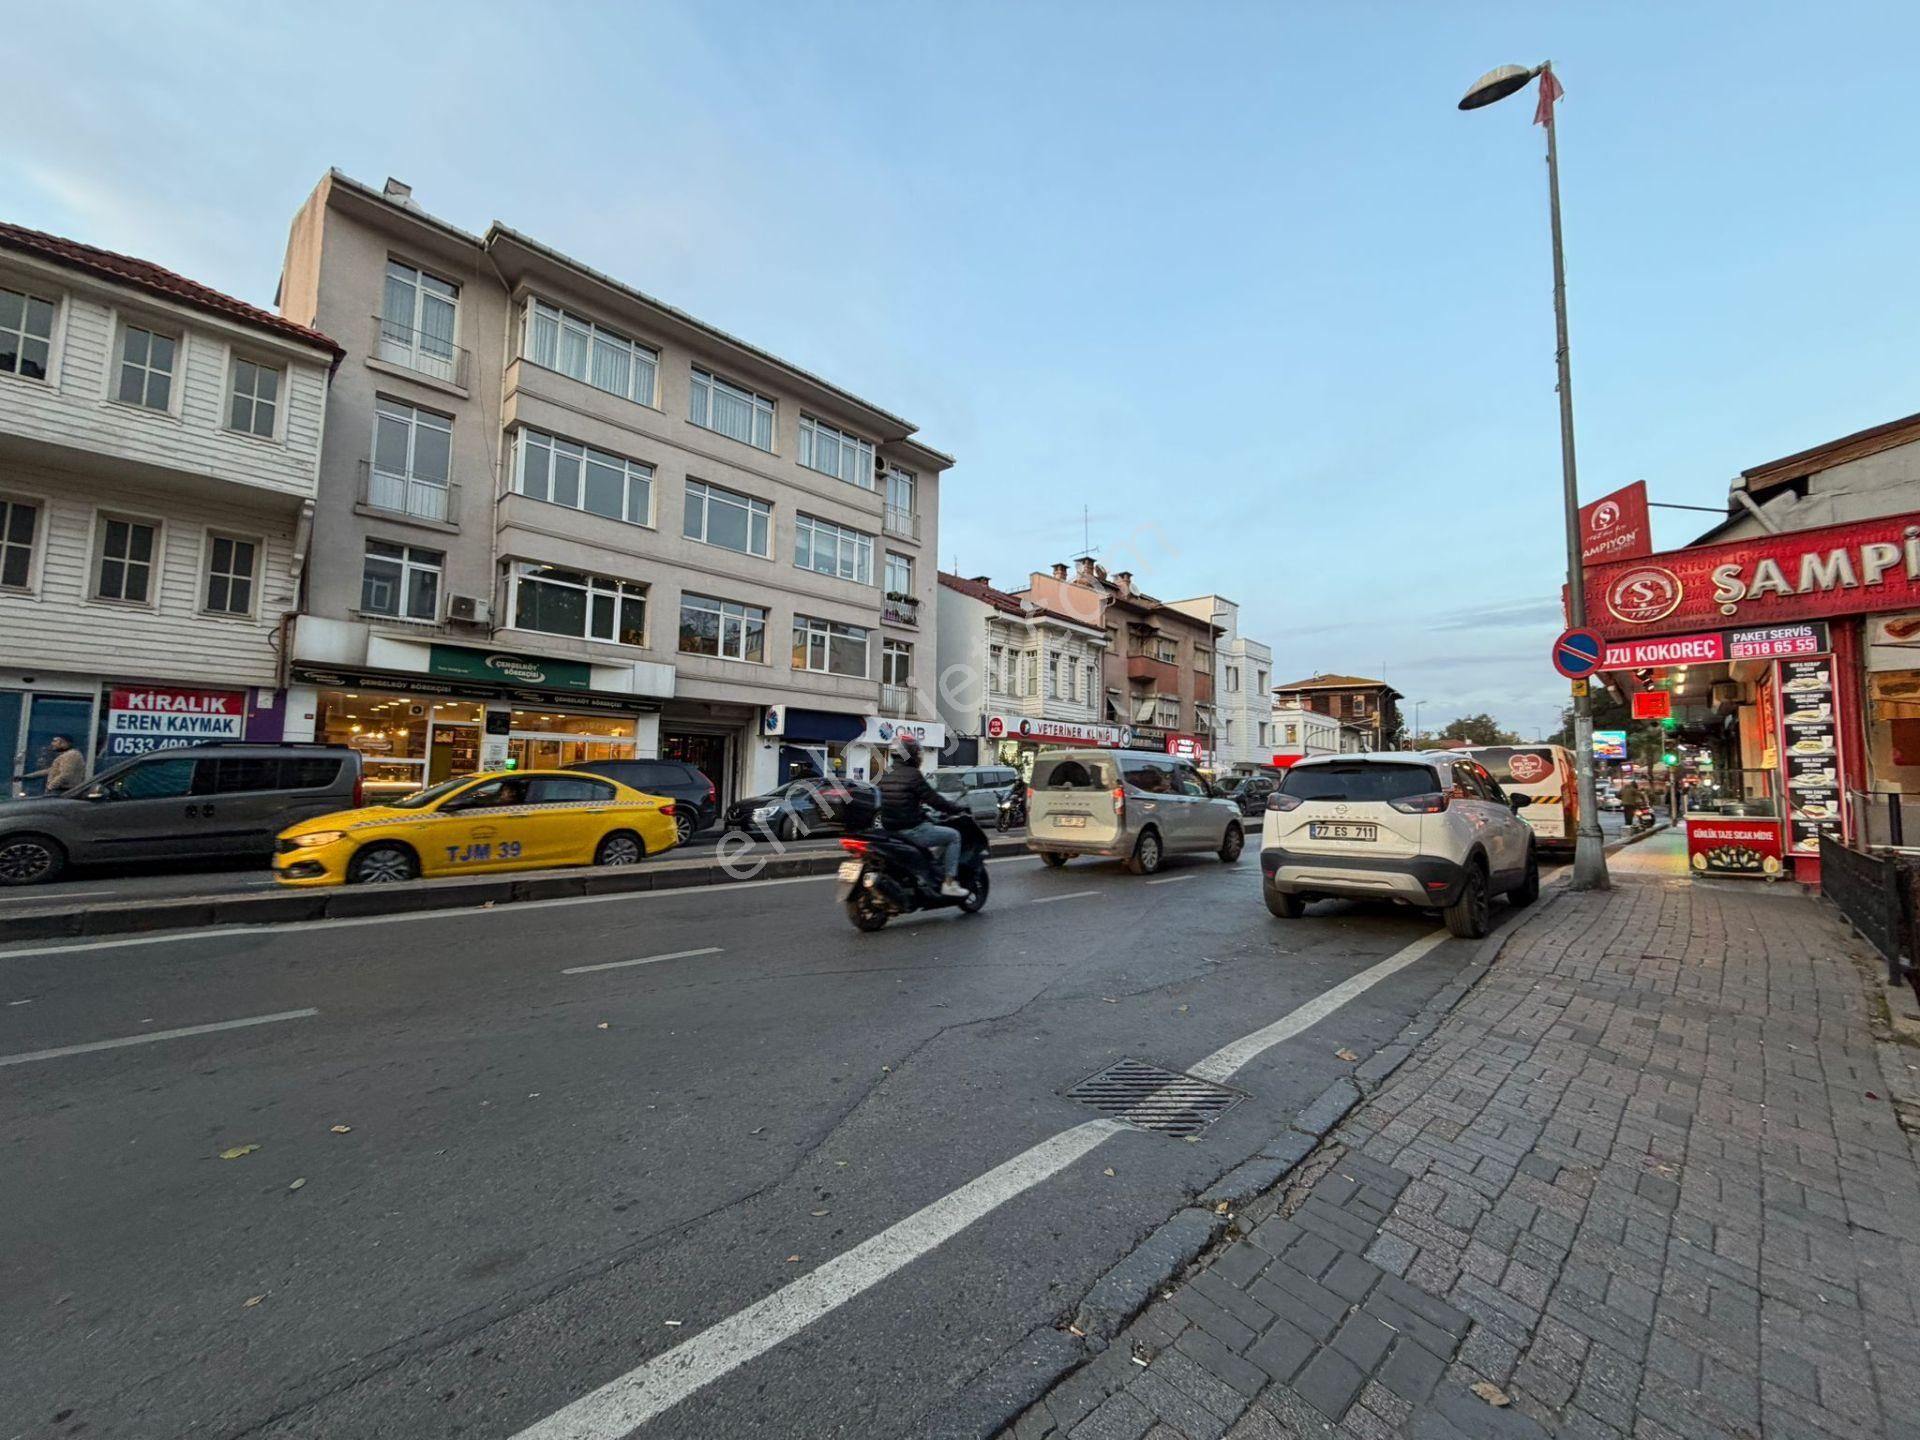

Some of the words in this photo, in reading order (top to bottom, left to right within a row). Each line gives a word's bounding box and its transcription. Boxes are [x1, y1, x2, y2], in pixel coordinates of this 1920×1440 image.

[1733, 630, 1768, 642] PAKET
[1770, 625, 1812, 639] SERVİS
[1636, 639, 1715, 662] KOKOREÇ
[1744, 642, 1770, 656] 318
[1774, 640, 1792, 653] 65
[1796, 638, 1815, 651] 55
[128, 691, 227, 713] KİRALIK
[116, 714, 161, 731] EREN
[167, 716, 235, 733] KAYMAK
[1037, 722, 1082, 737] VETERİNER
[114, 737, 154, 754] 0533
[1316, 826, 1329, 836] 77
[1334, 826, 1348, 837] ES
[1355, 827, 1373, 837] 711
[446, 843, 491, 862] TJM
[496, 840, 521, 859] 39
